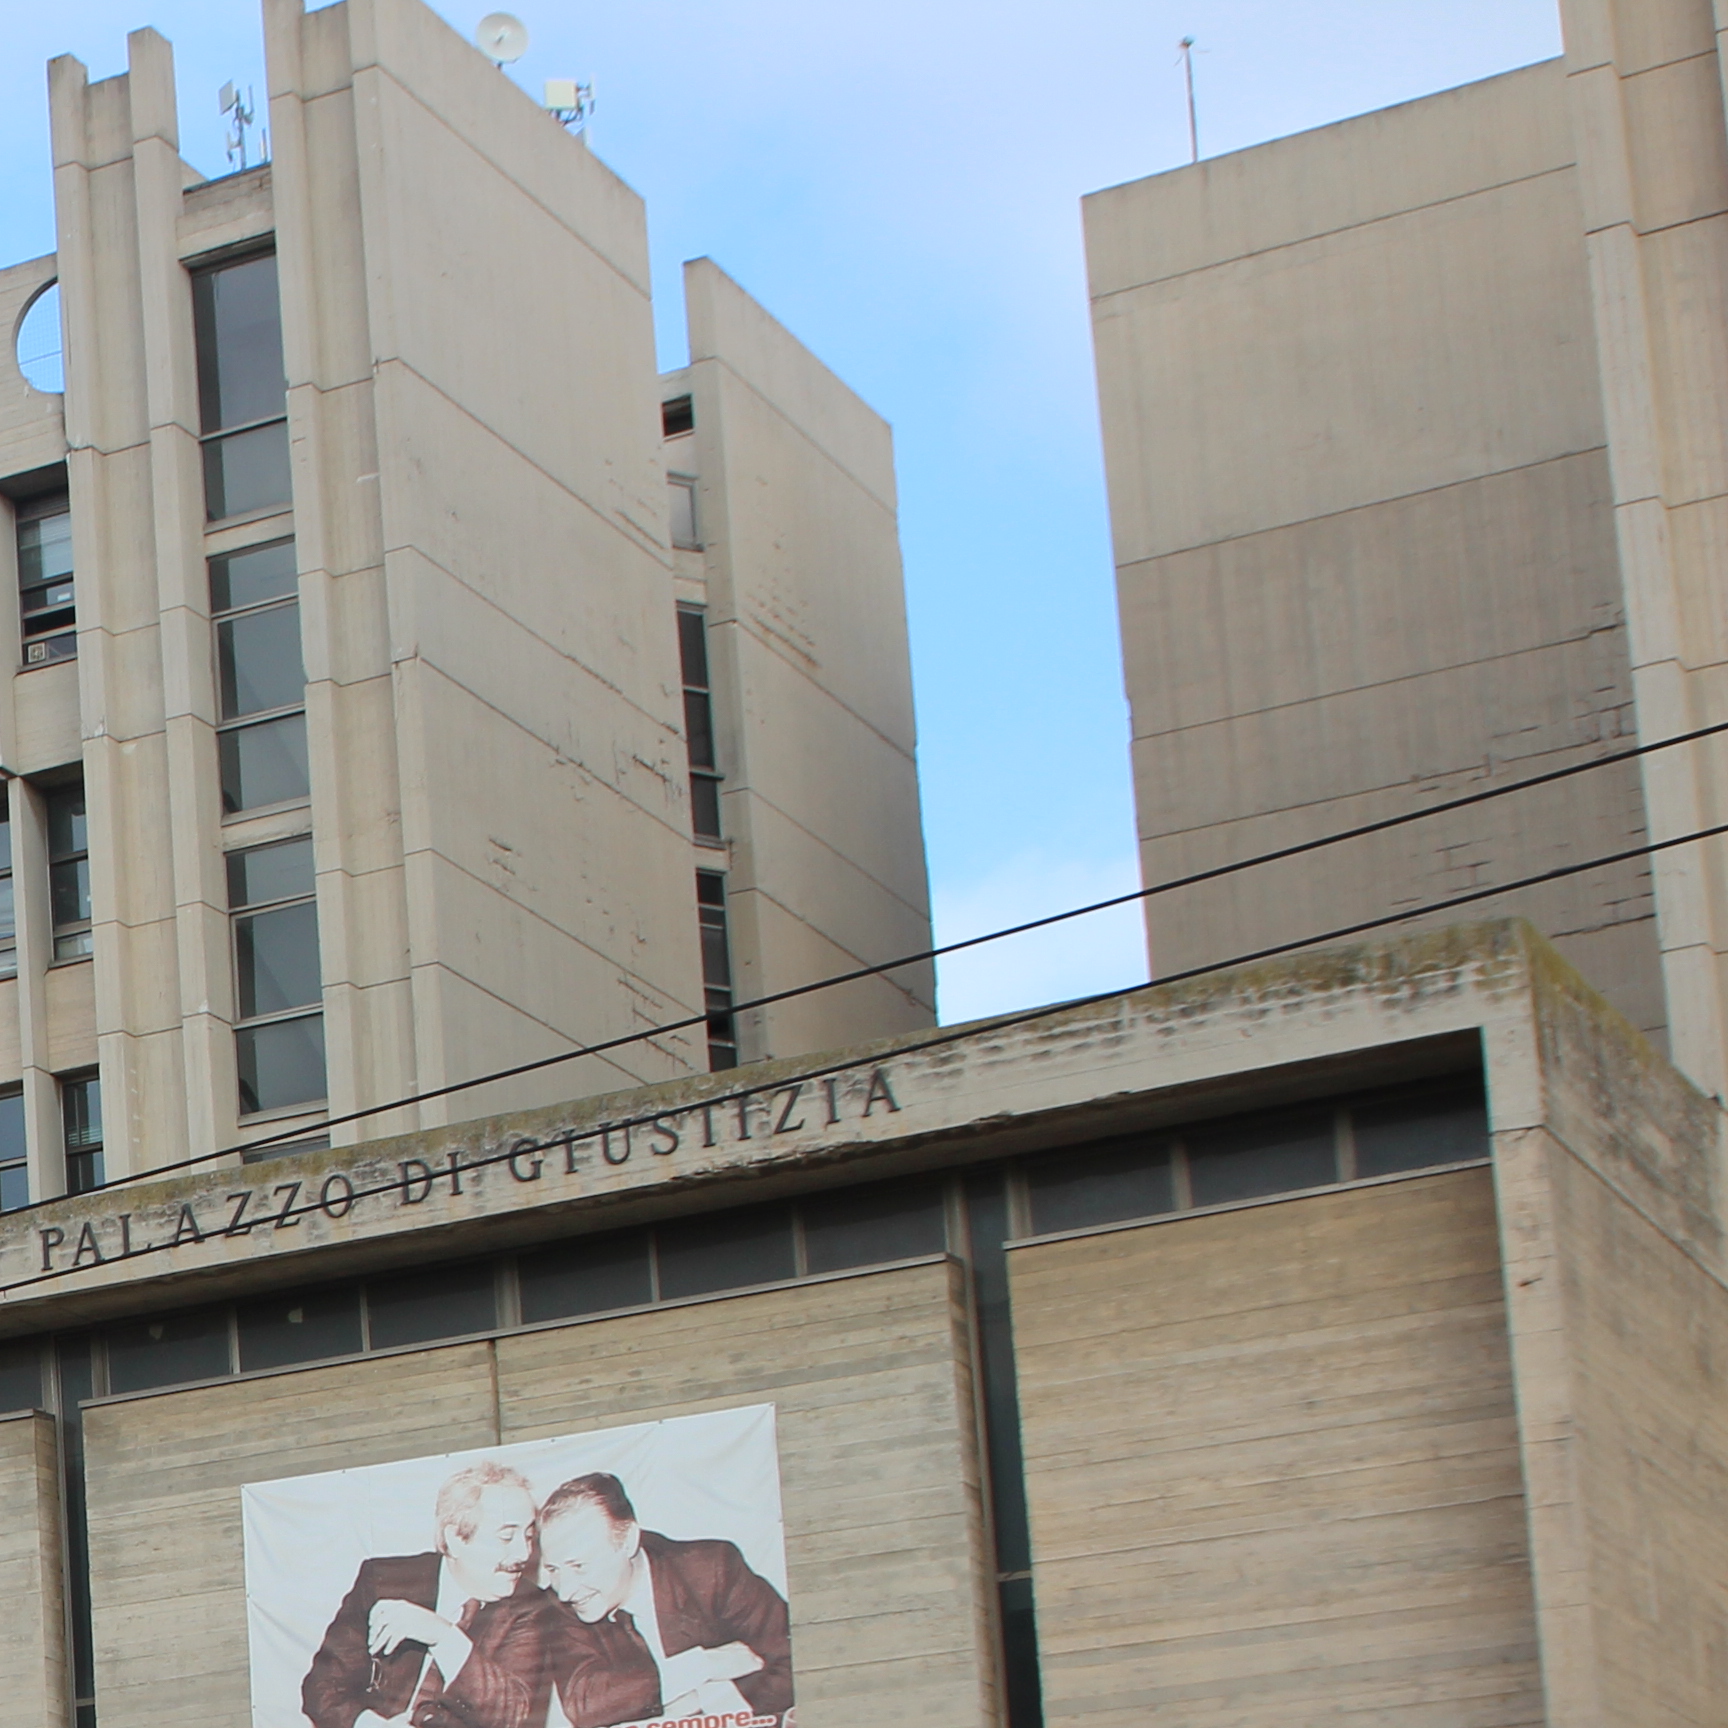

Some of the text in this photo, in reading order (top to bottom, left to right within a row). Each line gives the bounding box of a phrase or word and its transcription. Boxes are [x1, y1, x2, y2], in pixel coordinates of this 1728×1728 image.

[38, 1066, 902, 1272] PALAZZO DI GIUSTIZIA
